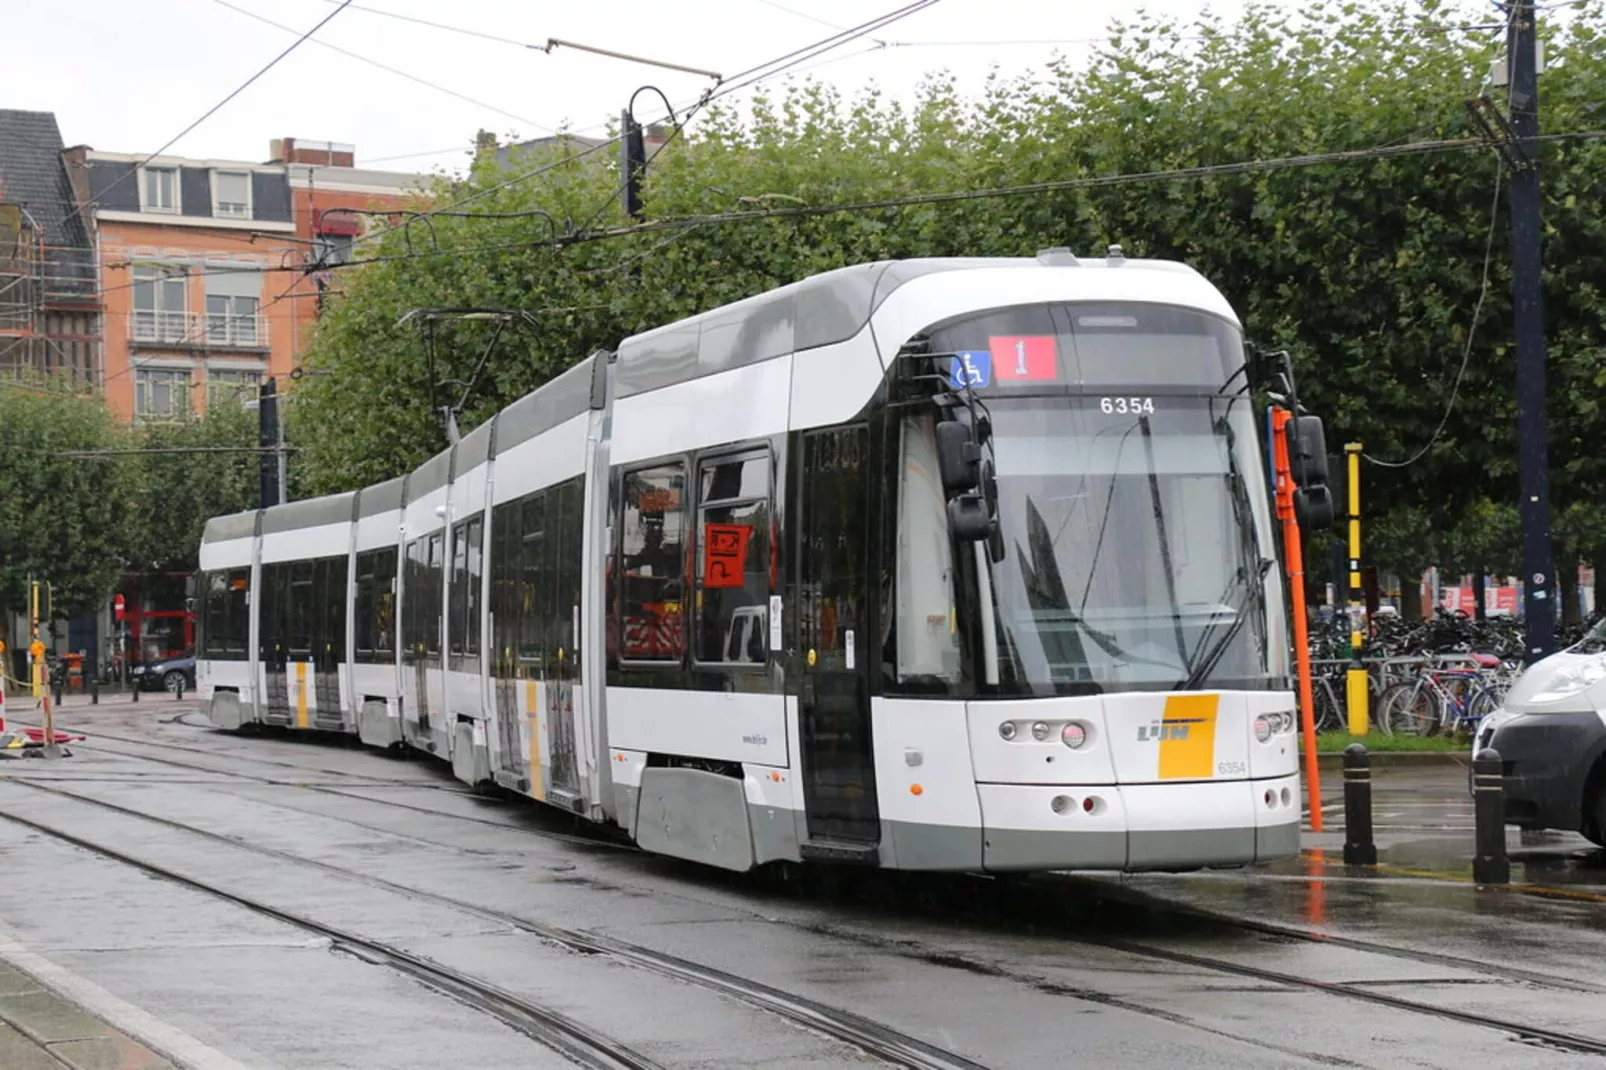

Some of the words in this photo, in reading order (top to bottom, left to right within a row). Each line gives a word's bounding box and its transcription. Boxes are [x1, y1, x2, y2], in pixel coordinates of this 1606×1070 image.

[1014, 340, 1028, 375] 1
[1100, 397, 1154, 414] 6354
[1218, 761, 1246, 774] 6354
